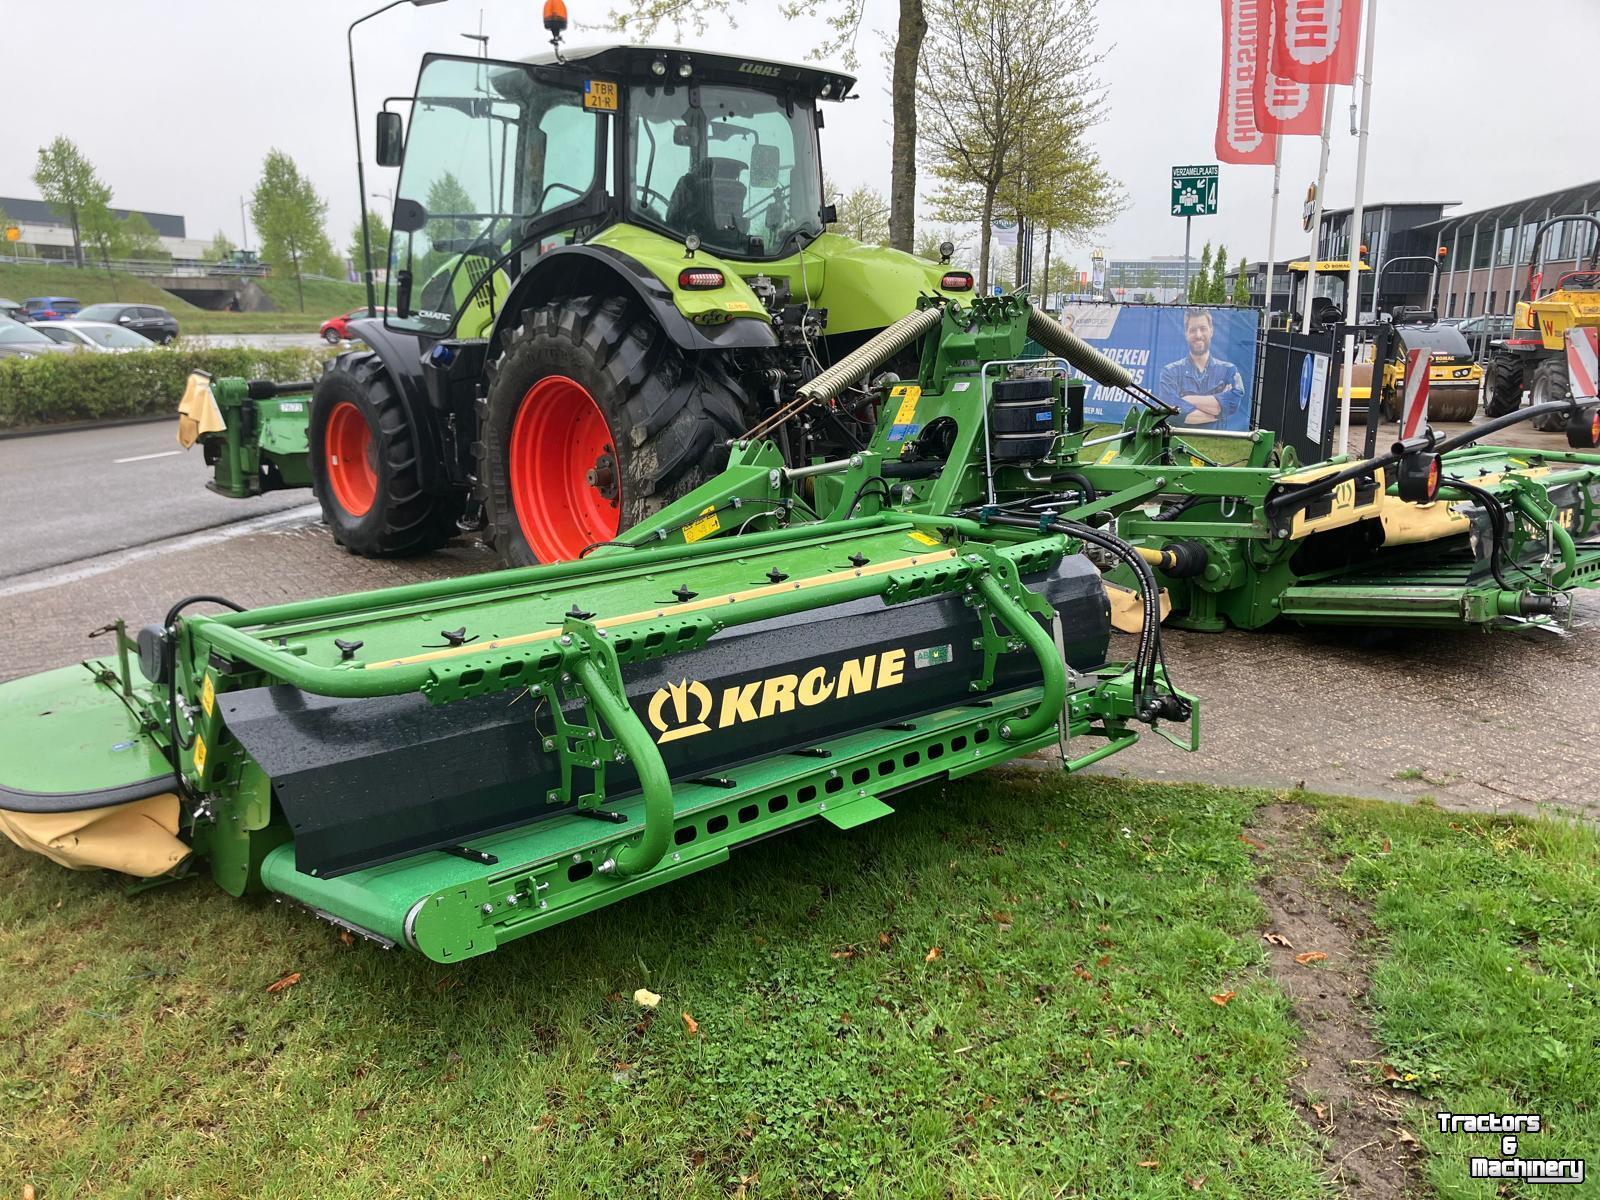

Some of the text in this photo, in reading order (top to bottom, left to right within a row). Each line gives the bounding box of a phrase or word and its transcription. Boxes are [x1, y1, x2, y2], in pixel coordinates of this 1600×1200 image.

[739, 62, 781, 77] CLAAS
[594, 82, 615, 95] TBR
[591, 95, 611, 108] 21-R
[1173, 166, 1218, 177] VERZAMELPLAATS
[1207, 182, 1217, 211] 4
[419, 310, 451, 321] CMATIC
[718, 648, 907, 728] KRONE
